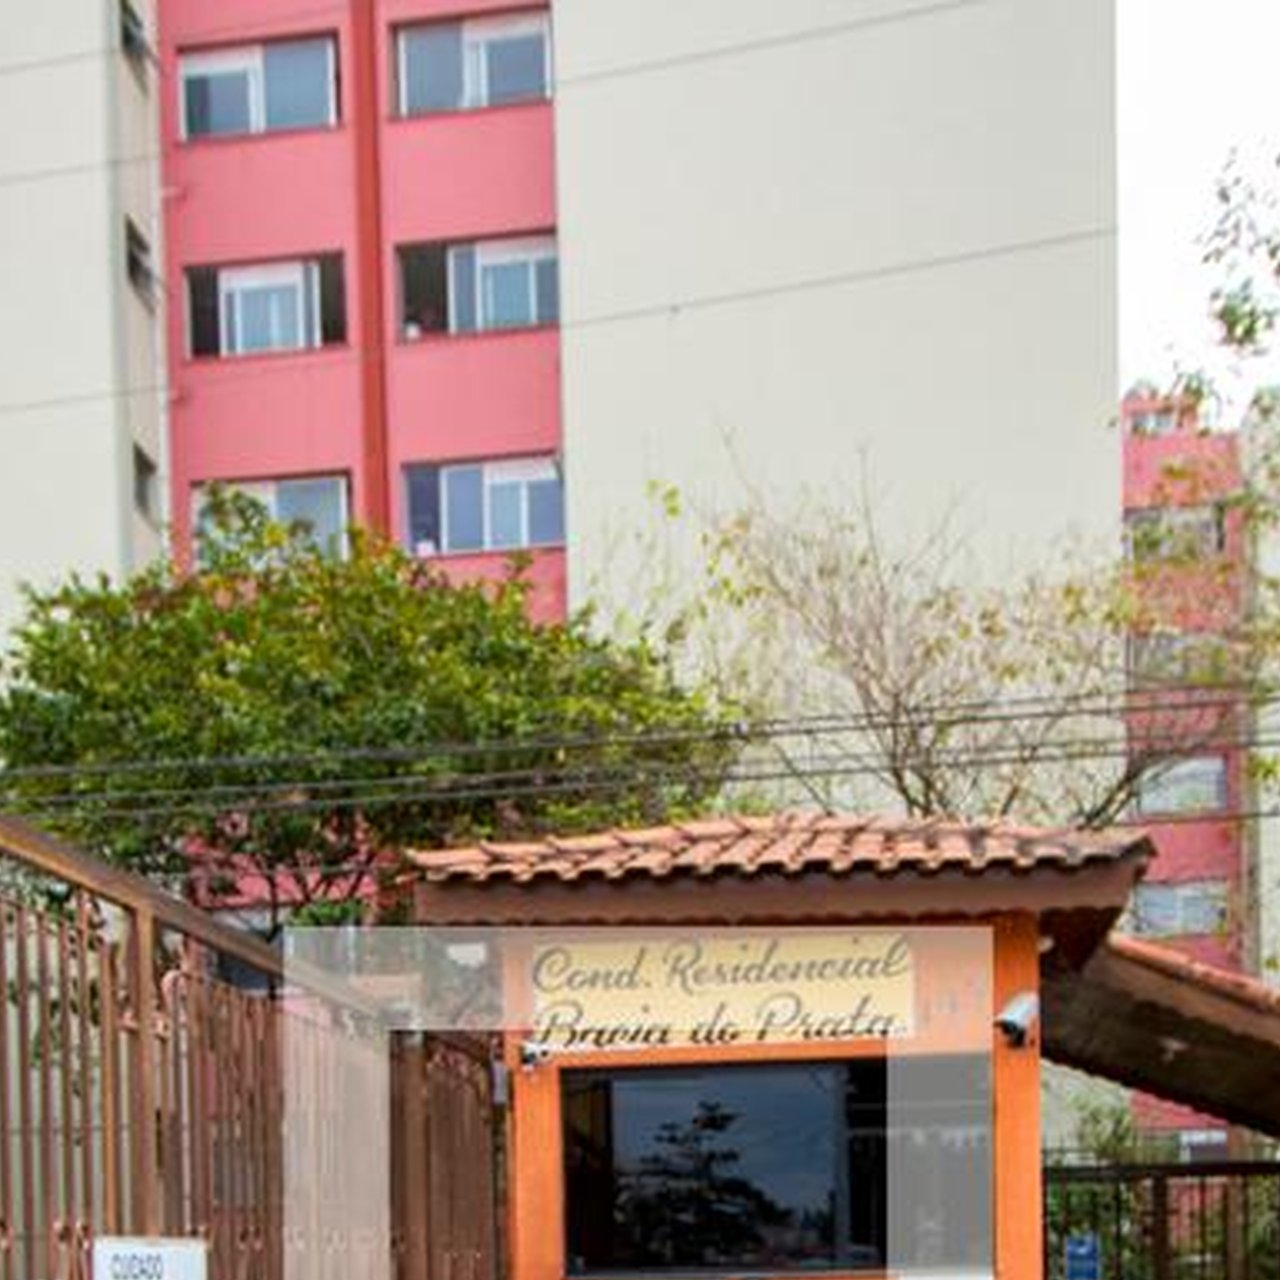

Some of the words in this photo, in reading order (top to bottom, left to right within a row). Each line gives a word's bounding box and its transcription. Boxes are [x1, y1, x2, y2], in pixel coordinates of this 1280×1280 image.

[533, 947, 651, 993] Cond.
[662, 934, 908, 996] Residencial
[755, 992, 907, 1041] Prata
[110, 1254, 163, 1280] CUIDADO
